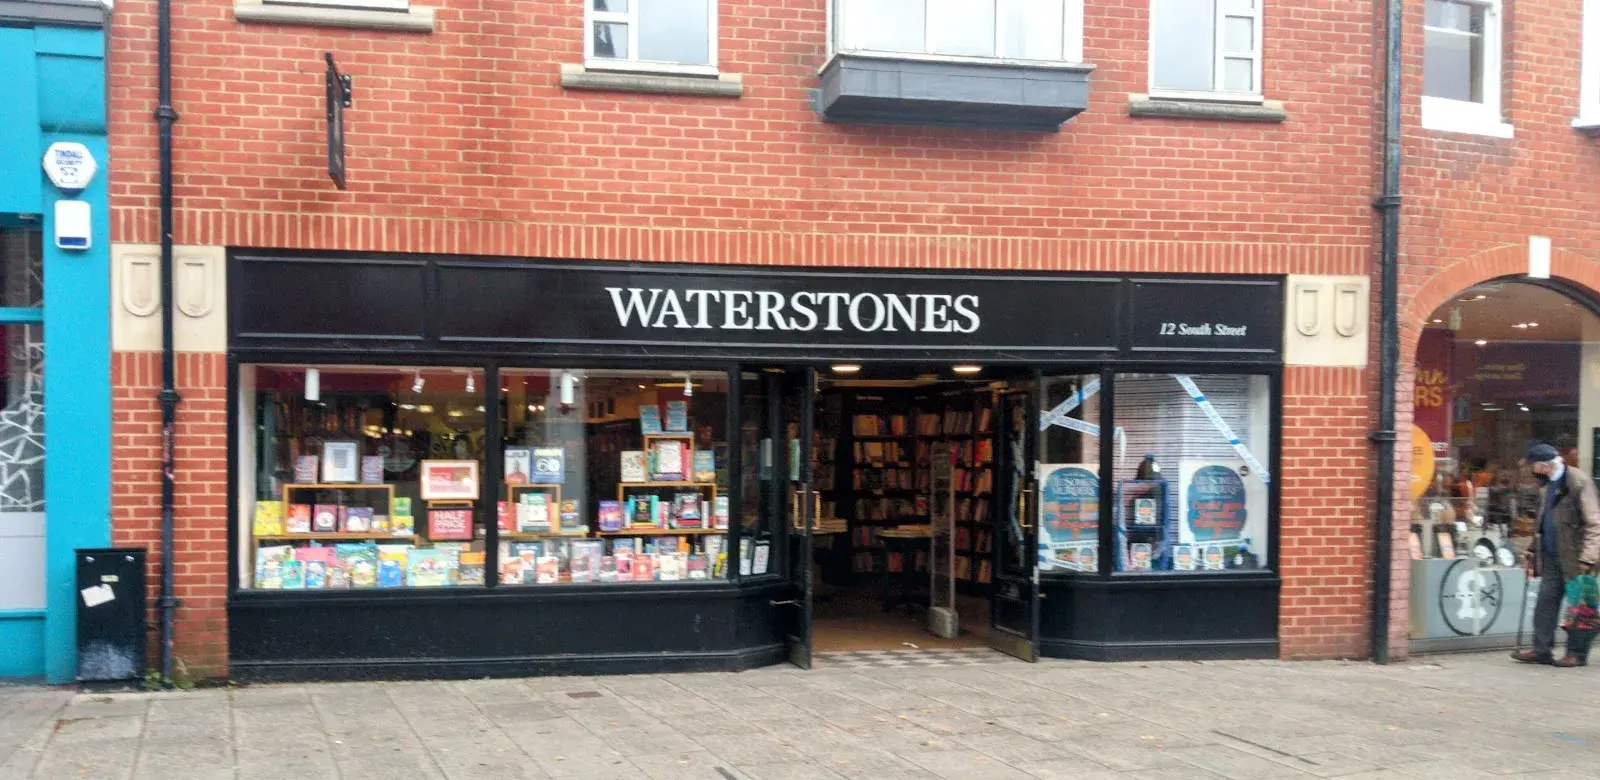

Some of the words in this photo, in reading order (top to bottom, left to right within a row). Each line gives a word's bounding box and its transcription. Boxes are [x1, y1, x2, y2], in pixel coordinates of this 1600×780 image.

[605, 287, 981, 334] WATERSTONES
[1159, 322, 1176, 335] 12
[1178, 322, 1213, 336] South
[1214, 323, 1248, 336] Street
[434, 510, 467, 519] HALF
